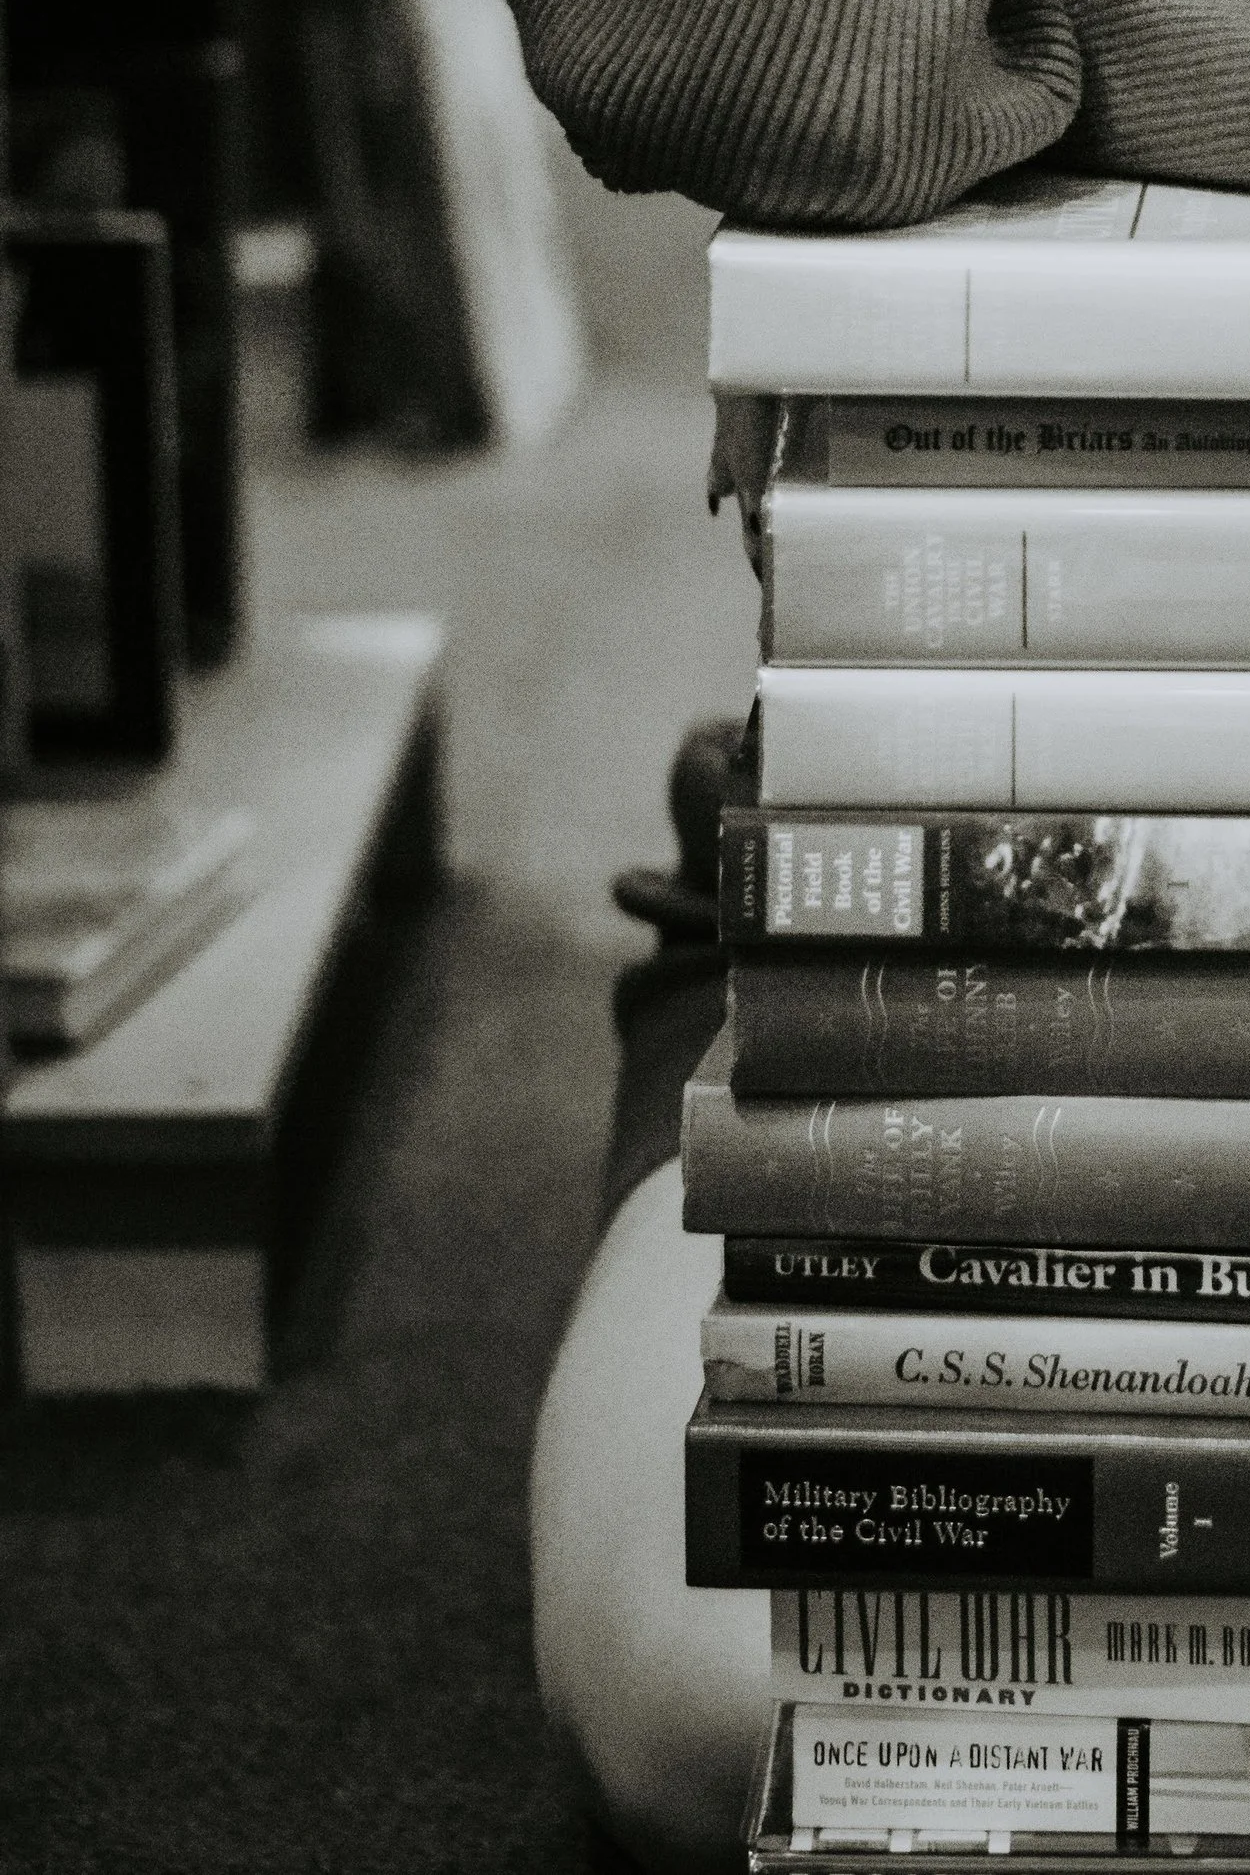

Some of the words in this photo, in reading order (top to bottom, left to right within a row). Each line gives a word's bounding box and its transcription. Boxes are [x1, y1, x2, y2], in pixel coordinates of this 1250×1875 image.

[883, 423, 940, 452] Out
[951, 424, 978, 452] of
[985, 424, 1026, 454] the
[1037, 424, 1133, 454] Briars
[1142, 433, 1169, 452] An
[904, 549, 922, 634] UNION
[925, 533, 944, 650] CAVALRY
[966, 559, 984, 627] CIVIL
[988, 562, 1006, 619] WAR
[862, 847, 882, 885] the
[892, 831, 912, 875] War
[938, 828, 951, 888] HOPKINS
[742, 838, 756, 920] LOSSING
[774, 832, 793, 926] Pictorial
[803, 852, 823, 908] Field
[833, 851, 852, 910] Book
[862, 888, 882, 914] of
[892, 881, 912, 931] Civil
[938, 890, 950, 933] JOHNS
[882, 1107, 905, 1150] OF
[774, 1253, 881, 1280] UTLEY
[918, 1246, 1117, 1290] Cavalier
[1130, 1256, 1180, 1294] in
[773, 1322, 793, 1395] WADDELL
[808, 1332, 825, 1388] HORAN
[894, 1348, 929, 1384] C.
[938, 1350, 971, 1386] S.
[981, 1353, 1013, 1388] S.
[763, 1480, 878, 1513] Military
[889, 1485, 1071, 1520] Bibliography
[1159, 1482, 1180, 1559] Volume
[762, 1520, 790, 1540] of
[799, 1520, 845, 1543] the
[855, 1521, 922, 1545] Civil
[934, 1523, 989, 1548] War
[799, 1589, 942, 1681] CIVIL
[958, 1591, 1075, 1686] WAR
[842, 1681, 1039, 1706] DICTIONARY
[813, 1741, 868, 1768] ONCE
[878, 1741, 938, 1769] UPON
[949, 1742, 962, 1769] A
[969, 1743, 1049, 1771] DISTANT
[1060, 1746, 1103, 1773] WAR
[1127, 1728, 1140, 1784] PROCHNAU
[818, 1794, 847, 1807] Young
[850, 1795, 868, 1806] War
[872, 1795, 947, 1809] Correspondents
[950, 1796, 967, 1807] and
[998, 1797, 1021, 1811] Early
[1025, 1798, 1063, 1811] Vietnam
[1066, 1799, 1099, 1812] Battles
[844, 1777, 871, 1789] David
[934, 1779, 952, 1790] Neil
[1002, 1781, 1027, 1792] Peter
[1127, 1786, 1139, 1831] WILLIAM
